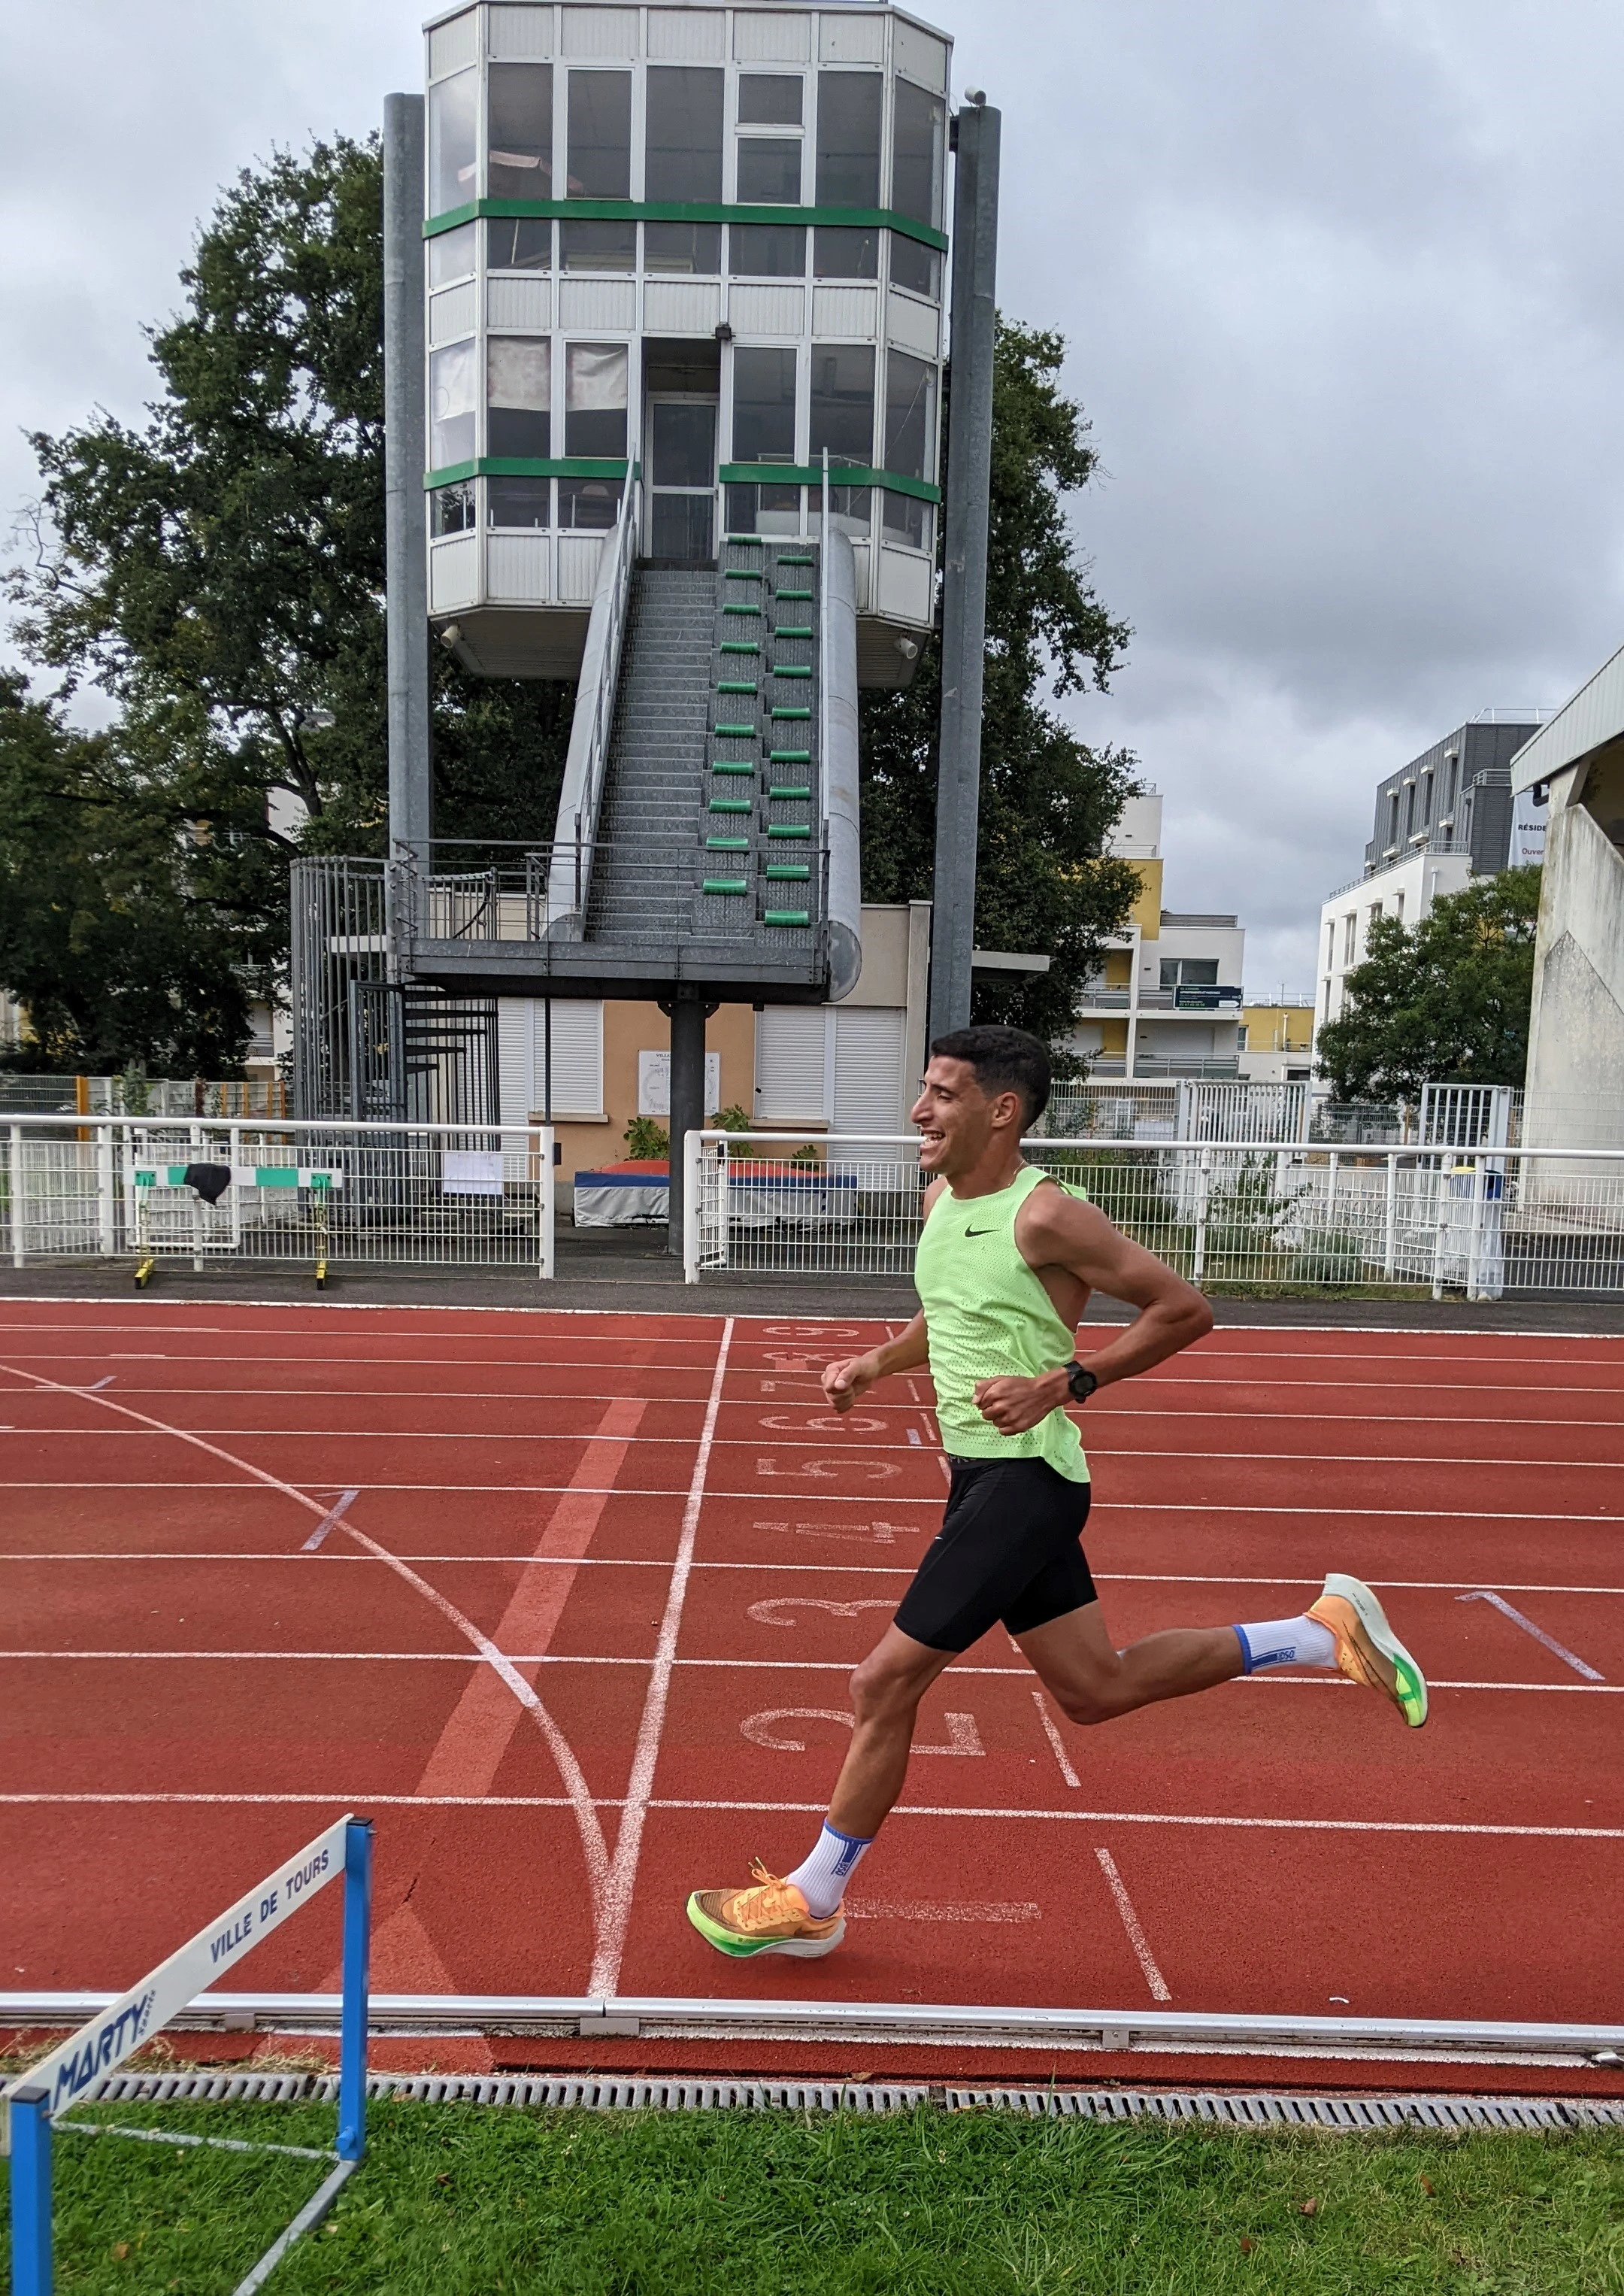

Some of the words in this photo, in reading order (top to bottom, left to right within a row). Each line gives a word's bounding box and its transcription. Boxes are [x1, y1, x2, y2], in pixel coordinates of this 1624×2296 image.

[758, 1416, 888, 1431] 6
[756, 1457, 902, 1479] 5
[753, 1521, 920, 1544] 4
[211, 1912, 252, 1963] VILLE
[260, 1889, 278, 1923] DE
[286, 1849, 329, 1900] TOURS
[53, 1994, 148, 2111] MARTY
